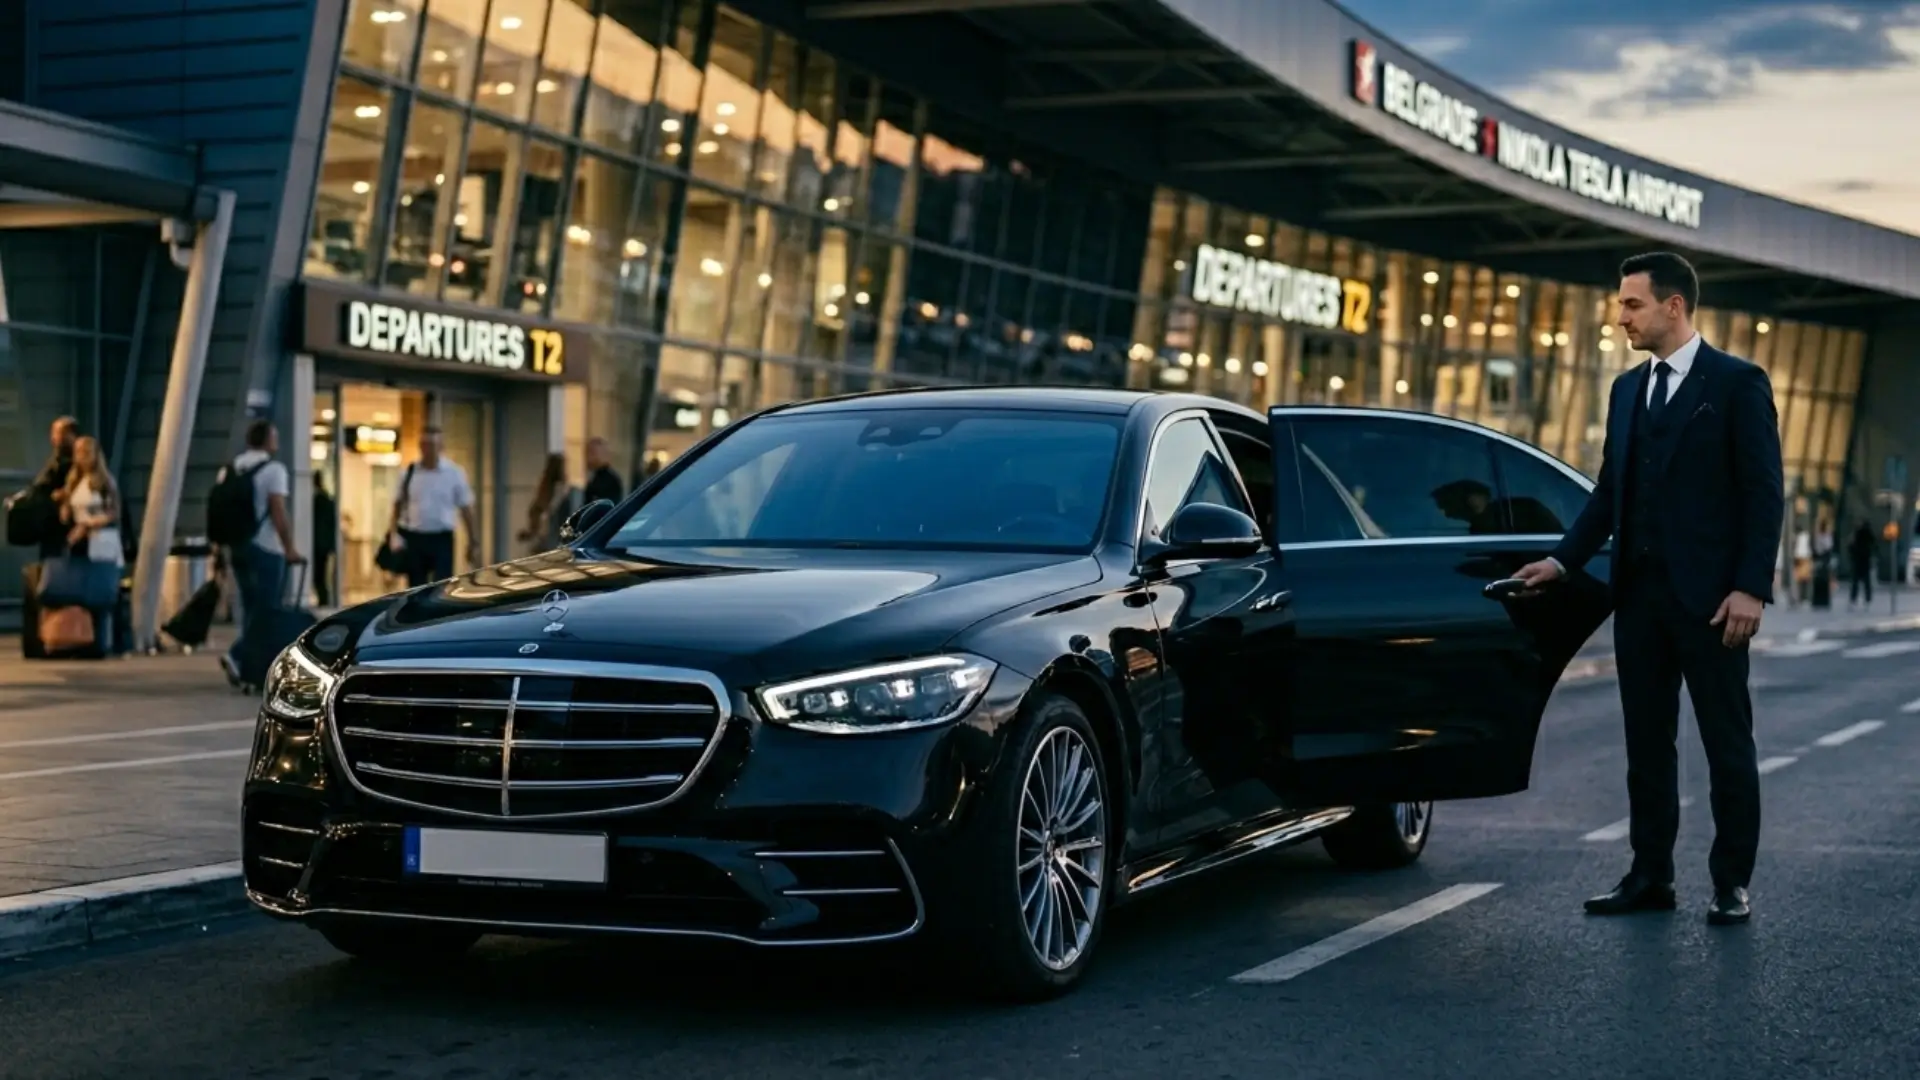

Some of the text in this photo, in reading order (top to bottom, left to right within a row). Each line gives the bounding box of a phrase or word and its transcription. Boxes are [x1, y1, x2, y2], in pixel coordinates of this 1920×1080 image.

[1384, 62, 1704, 229] BELGRADE NIKOLA TESLA AIRPORT
[1194, 244, 1341, 329] DEPARTURES
[350, 301, 563, 375] DEPARTURES T2
